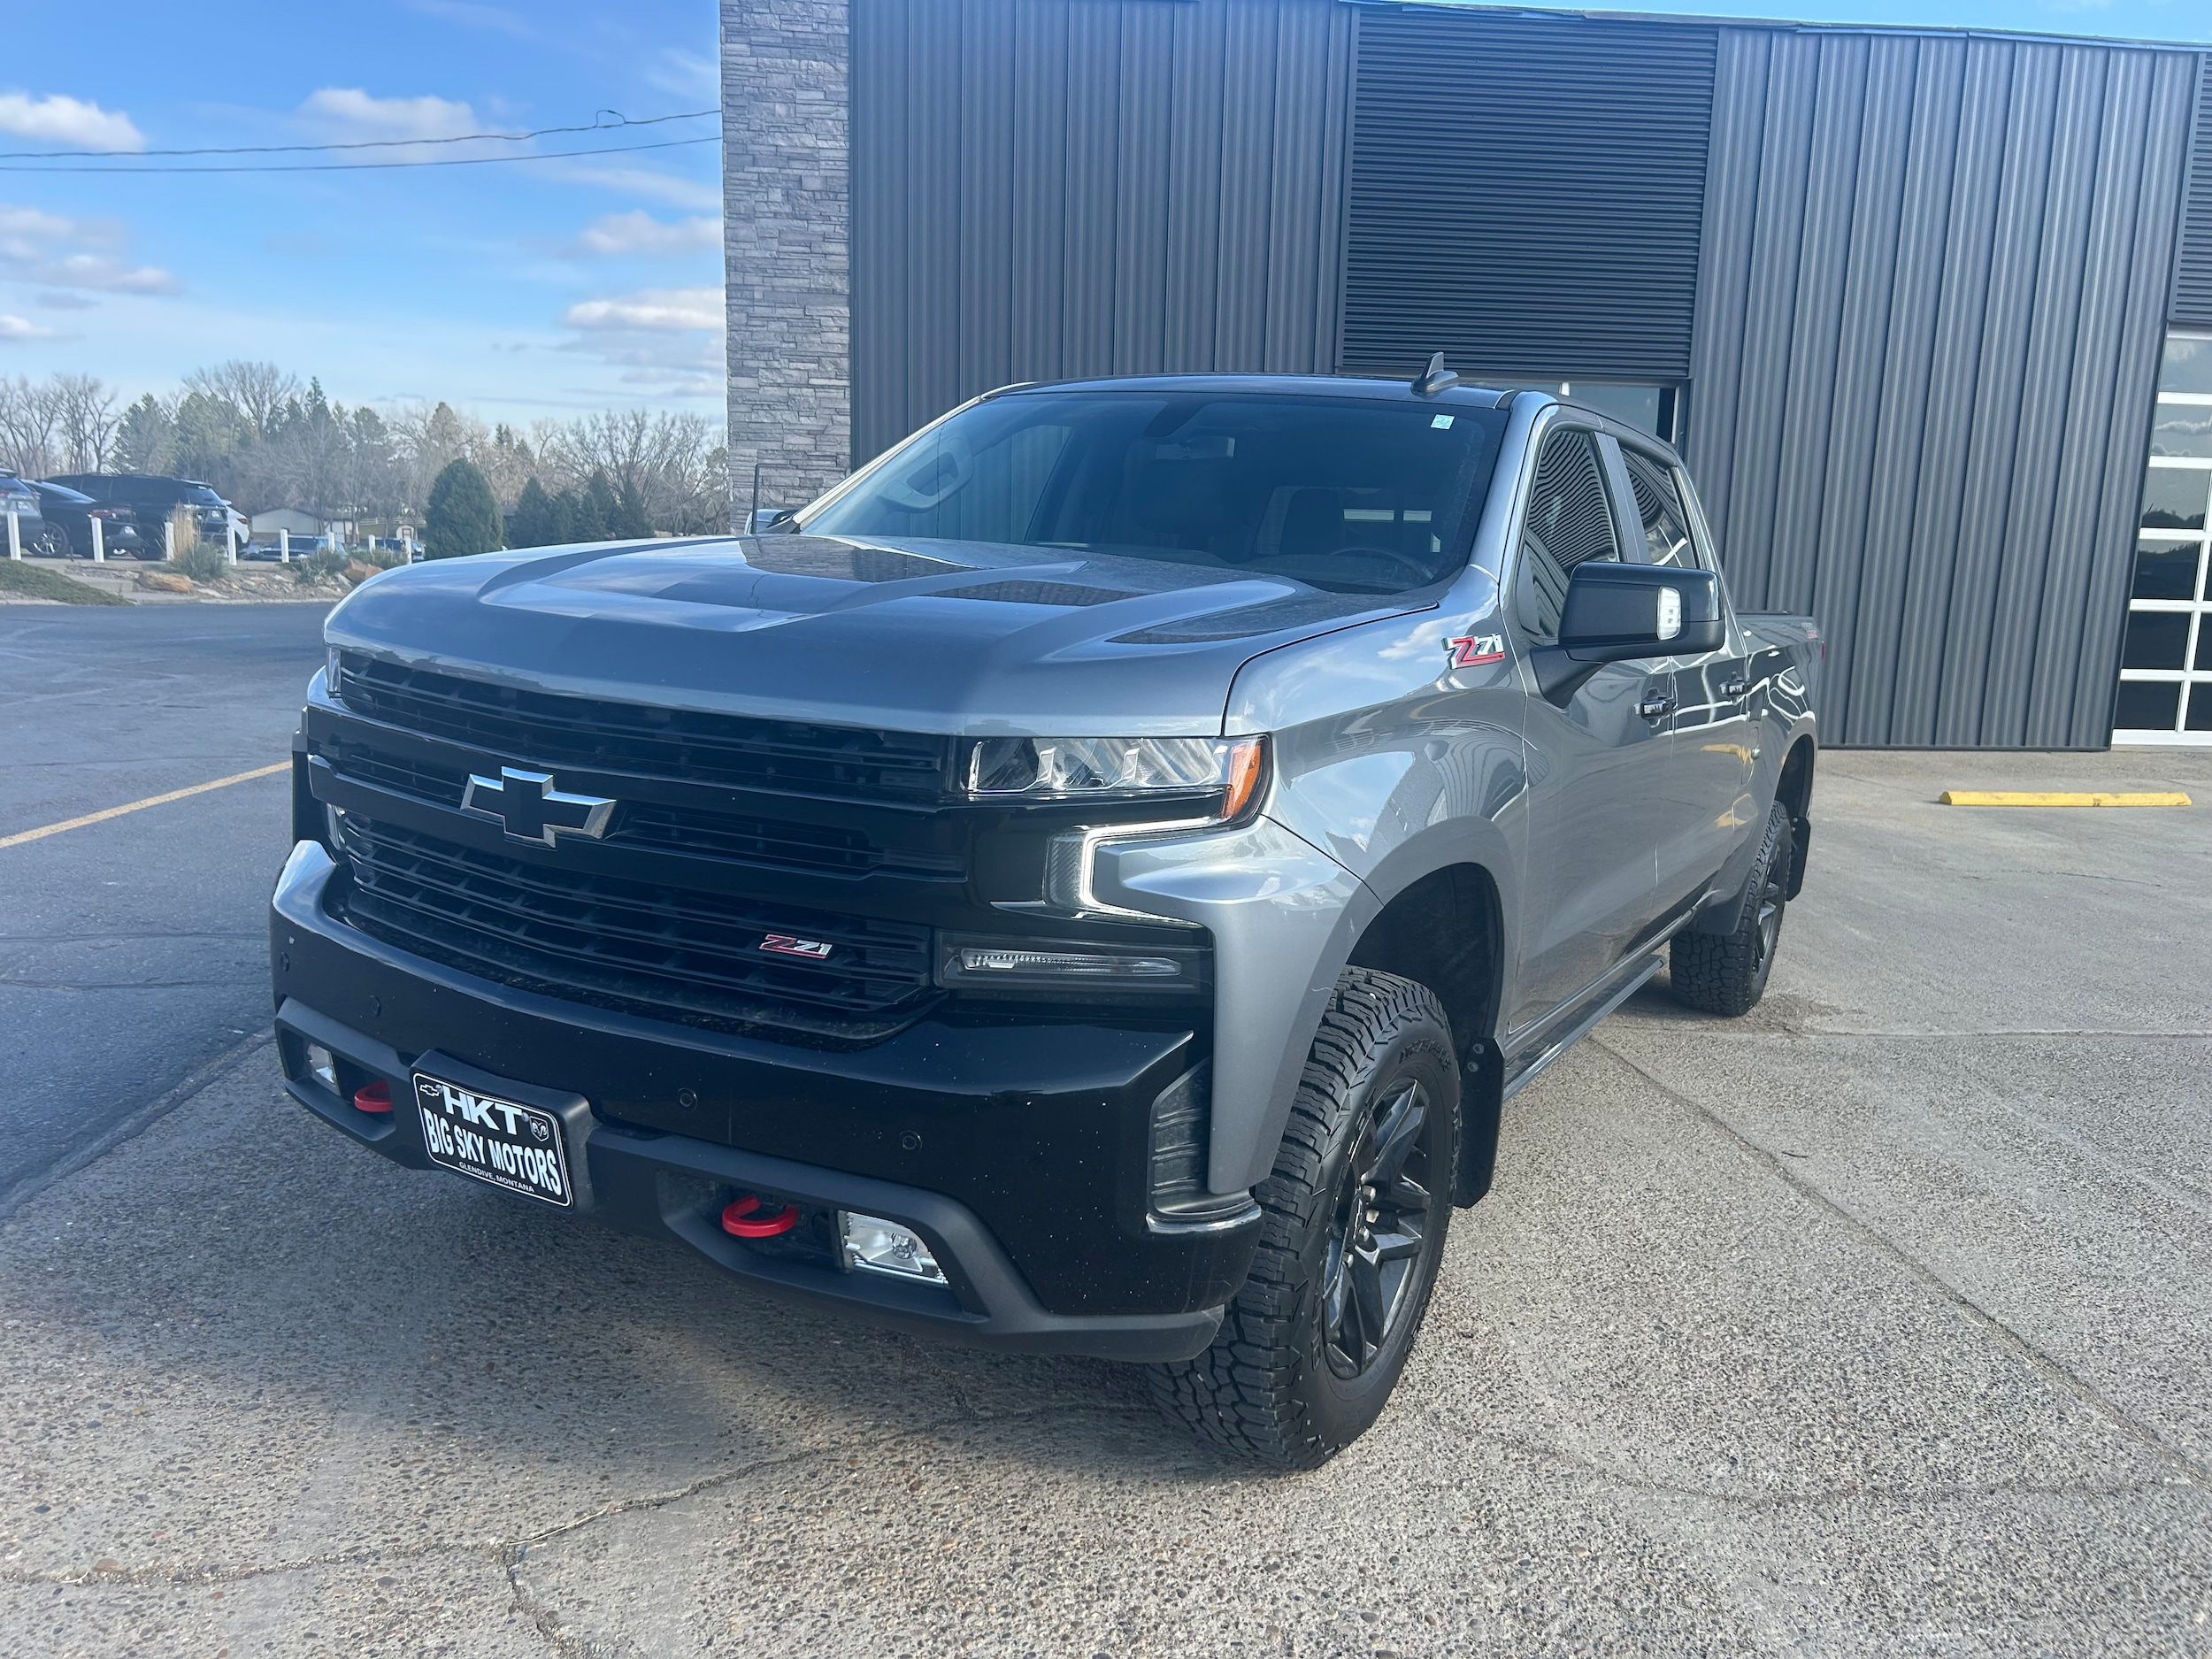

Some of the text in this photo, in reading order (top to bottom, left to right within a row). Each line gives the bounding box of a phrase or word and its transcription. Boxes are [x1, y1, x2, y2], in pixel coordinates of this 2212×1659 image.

[1440, 634, 1505, 670] Z71
[758, 933, 833, 959] Z71
[442, 1086, 523, 1135] HKT
[423, 1107, 562, 1195] BIG SKY MOTORS
[458, 1161, 534, 1193] GLENDIVE, MONTANA
